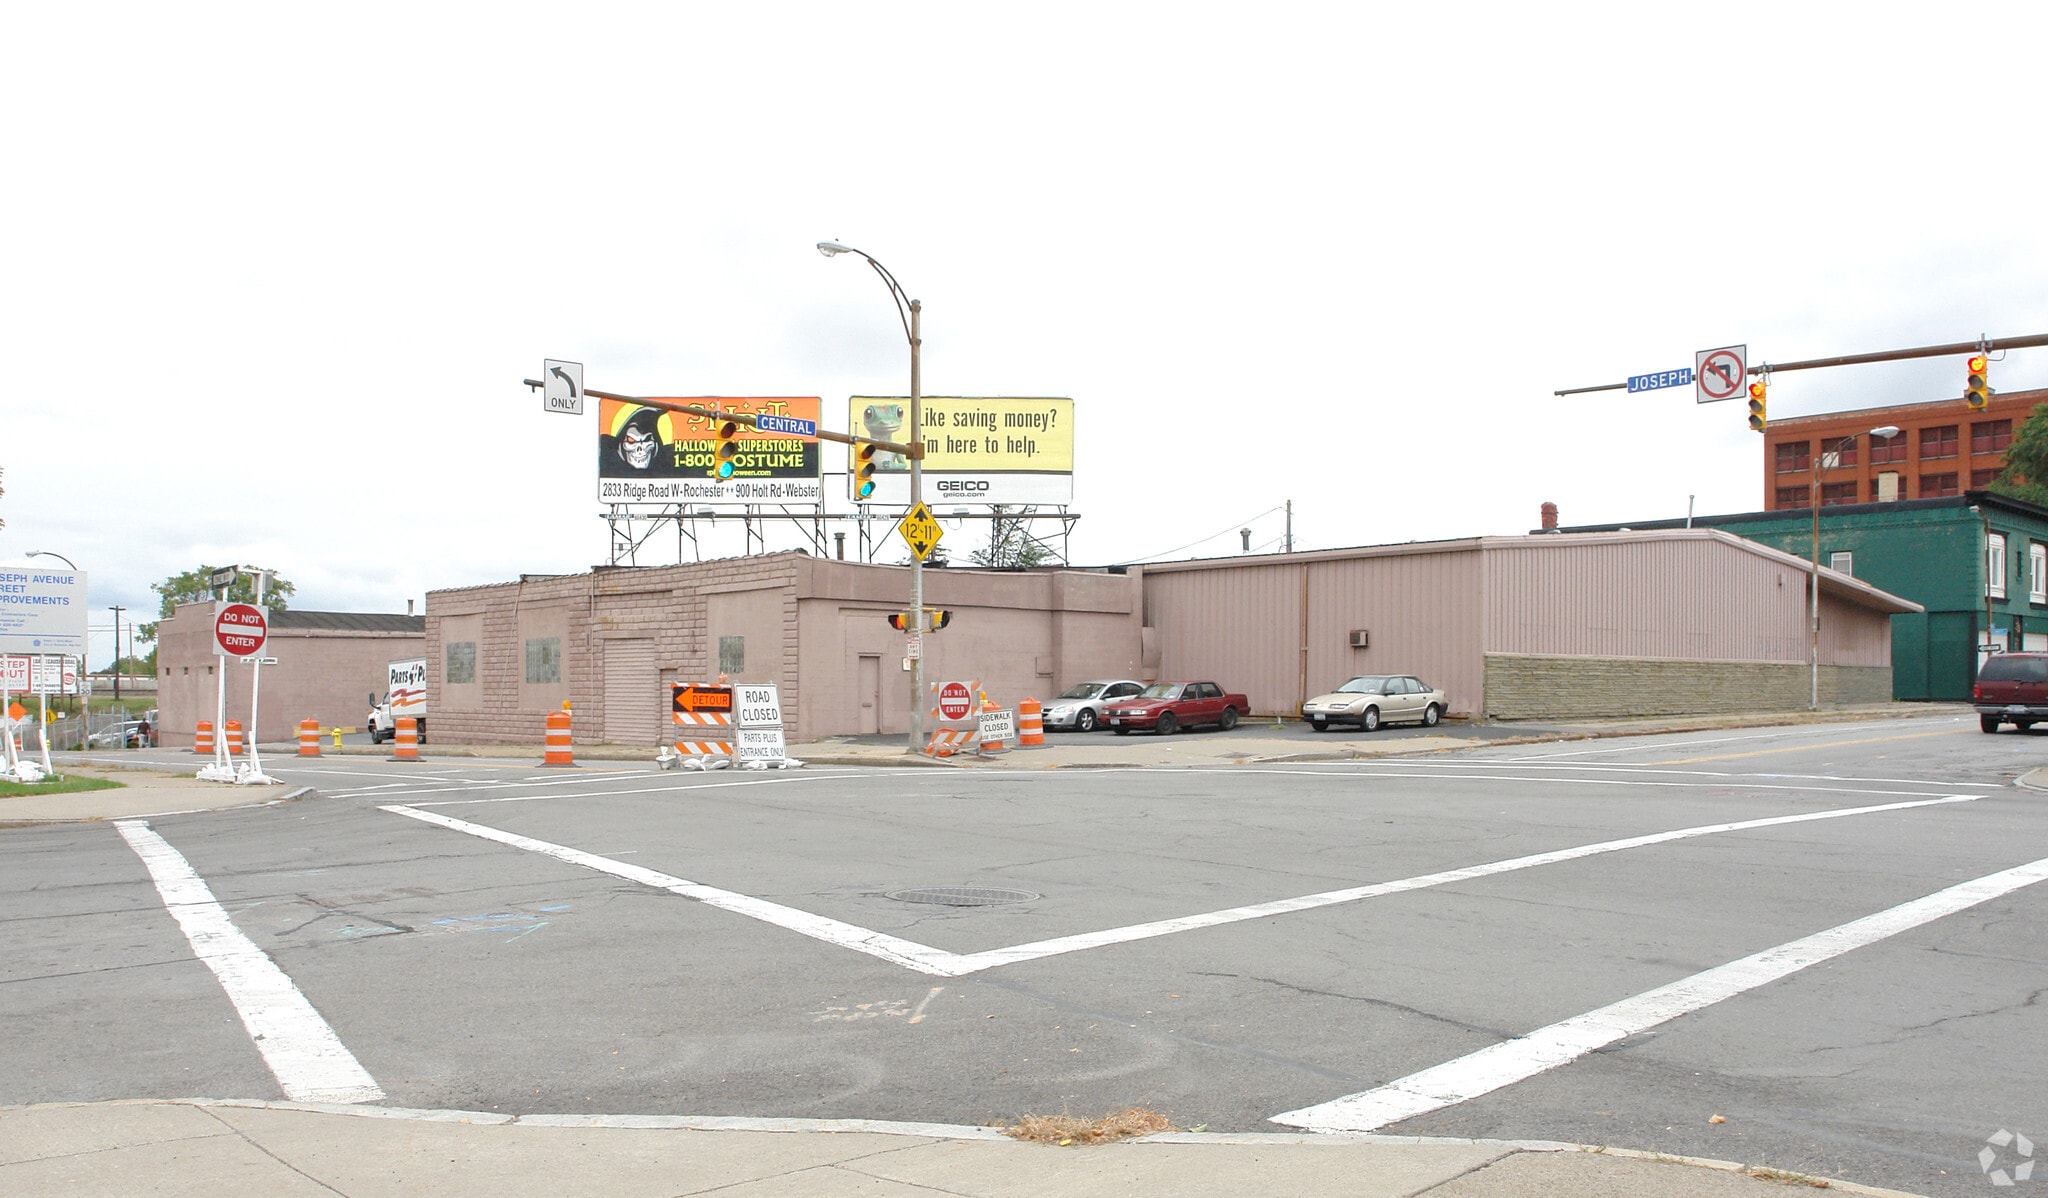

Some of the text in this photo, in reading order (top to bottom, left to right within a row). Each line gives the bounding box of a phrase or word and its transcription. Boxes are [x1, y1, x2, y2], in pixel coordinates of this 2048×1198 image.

[1631, 370, 1688, 391] JOSEPH
[551, 397, 576, 409] ONLY
[920, 407, 1057, 432] ike saving money?
[761, 417, 812, 434] CENTRAL
[674, 440, 804, 452] HALLOW SUPERSTORES
[922, 435, 1040, 458] 'm here to help.
[937, 481, 989, 491] GEICO
[603, 483, 621, 497] 2833
[624, 483, 646, 501] Ridge
[648, 484, 669, 498] Road
[735, 484, 750, 498] 900
[752, 483, 768, 498] Holt
[0, 574, 74, 584] SEPH AVENUE
[0, 585, 26, 593] REET
[224, 613, 260, 624] DO NOT
[226, 636, 255, 647] ENTER
[7, 669, 25, 678] UT
[391, 669, 408, 685] PARTS
[692, 695, 728, 705] DETOUR
[745, 690, 770, 703] ROAD
[742, 708, 778, 721] CLOSED
[980, 712, 1011, 722] SIDEWALK
[984, 723, 1008, 732] CLOSED
[744, 733, 777, 743] PARTS PLUS
[740, 747, 784, 757] ENTRANCE ONLY
